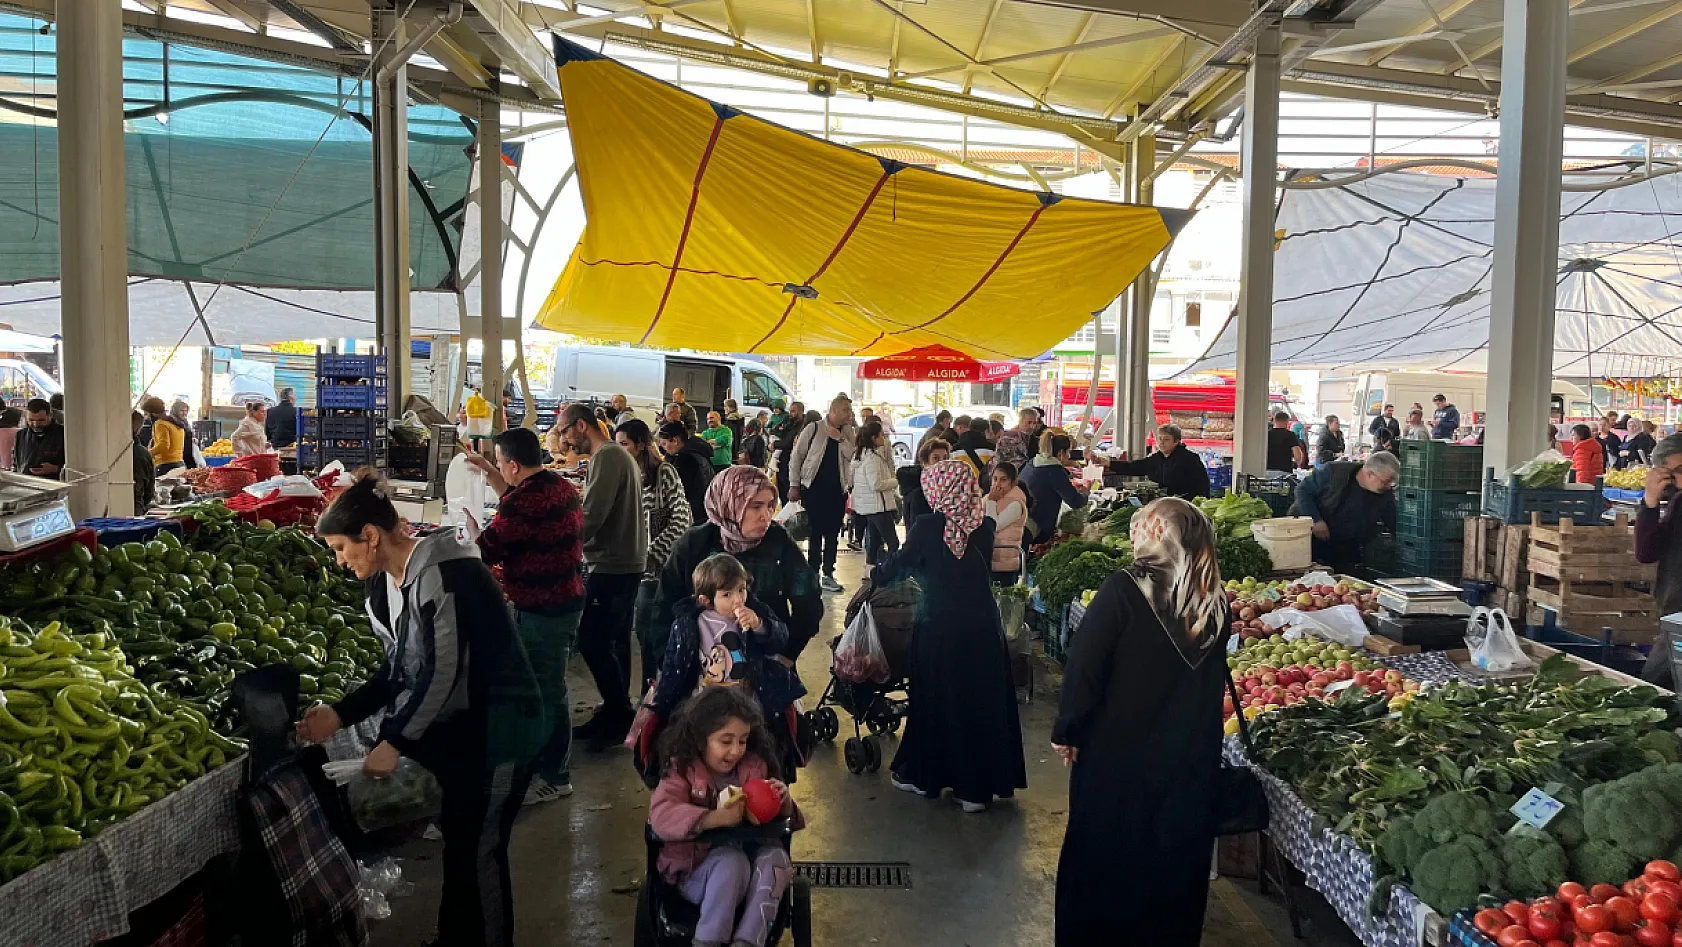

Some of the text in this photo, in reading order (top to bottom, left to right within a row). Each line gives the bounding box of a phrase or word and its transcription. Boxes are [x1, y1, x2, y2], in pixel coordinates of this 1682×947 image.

[875, 368, 906, 378] ALGIDA
[927, 369, 967, 379] ALGIDA
[987, 365, 1012, 376] ALGIDA
